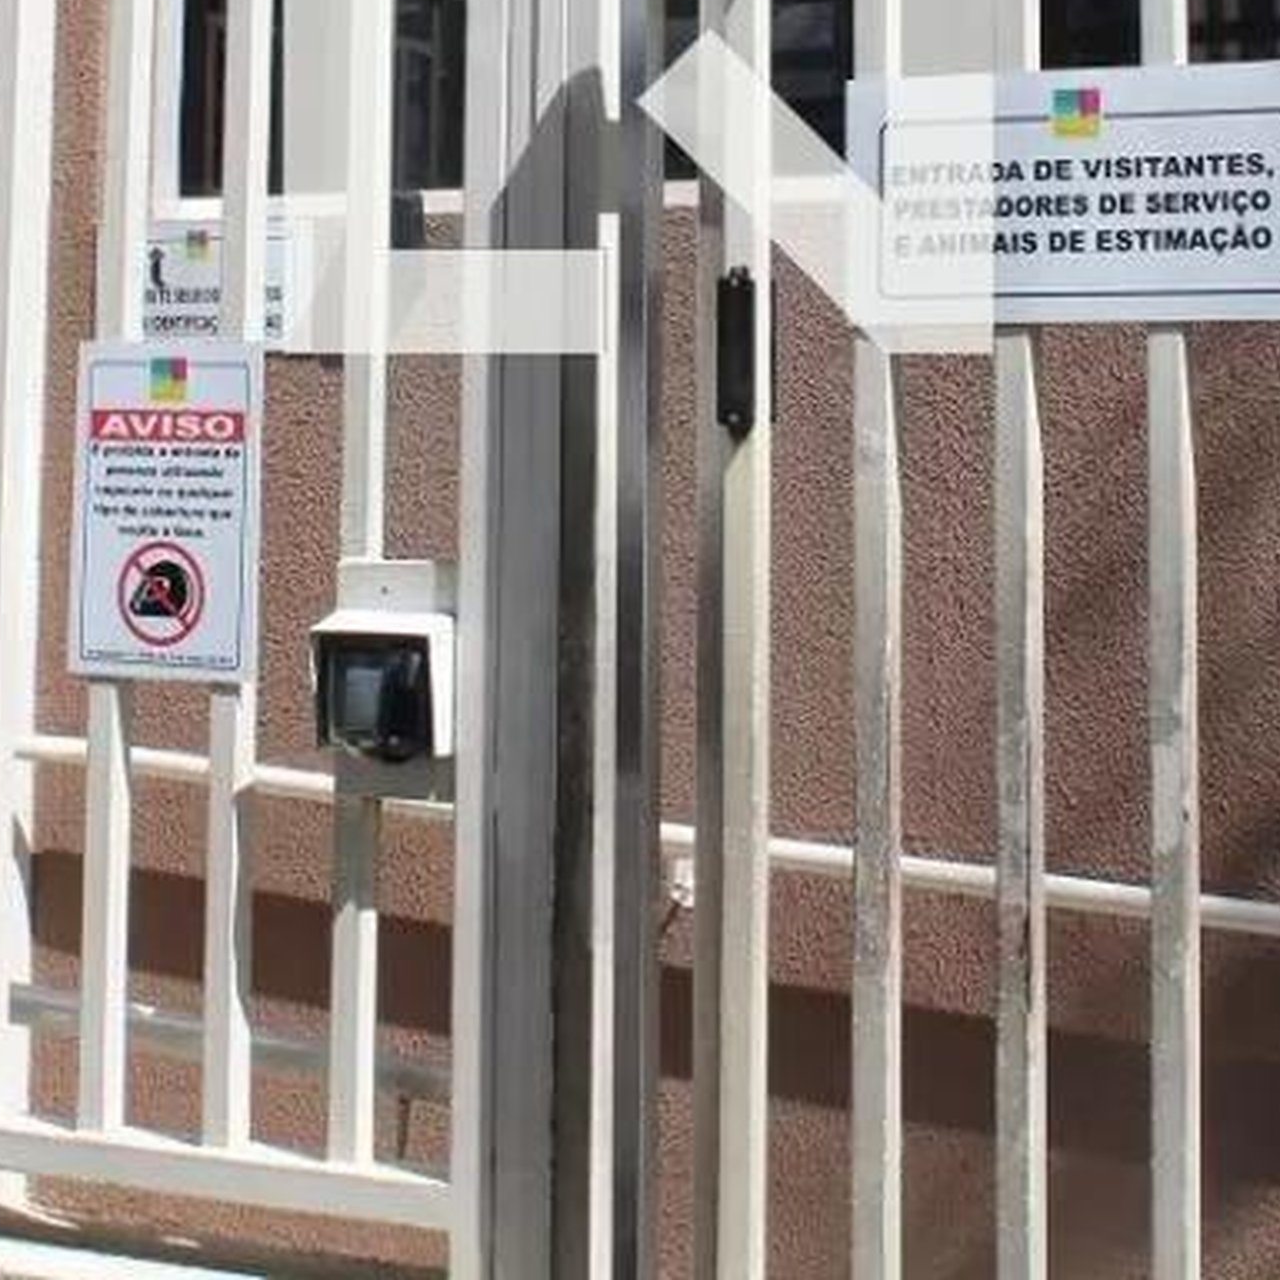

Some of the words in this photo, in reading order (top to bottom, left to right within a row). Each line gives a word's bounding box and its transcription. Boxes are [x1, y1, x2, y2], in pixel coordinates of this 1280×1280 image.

[892, 160, 1025, 186] ENTRADA
[1034, 158, 1072, 182] DE
[1082, 152, 1275, 180] VISITANTES,
[894, 194, 1089, 220] PRESTADORES
[1100, 192, 1136, 216] DE
[1146, 189, 1272, 218] SERVIÇO
[895, 233, 910, 258] E
[919, 230, 1038, 257] ANIMAIS
[1049, 229, 1085, 254] DE
[1096, 224, 1273, 256] ESTIMAÇÃO
[99, 414, 235, 439] AVISO
